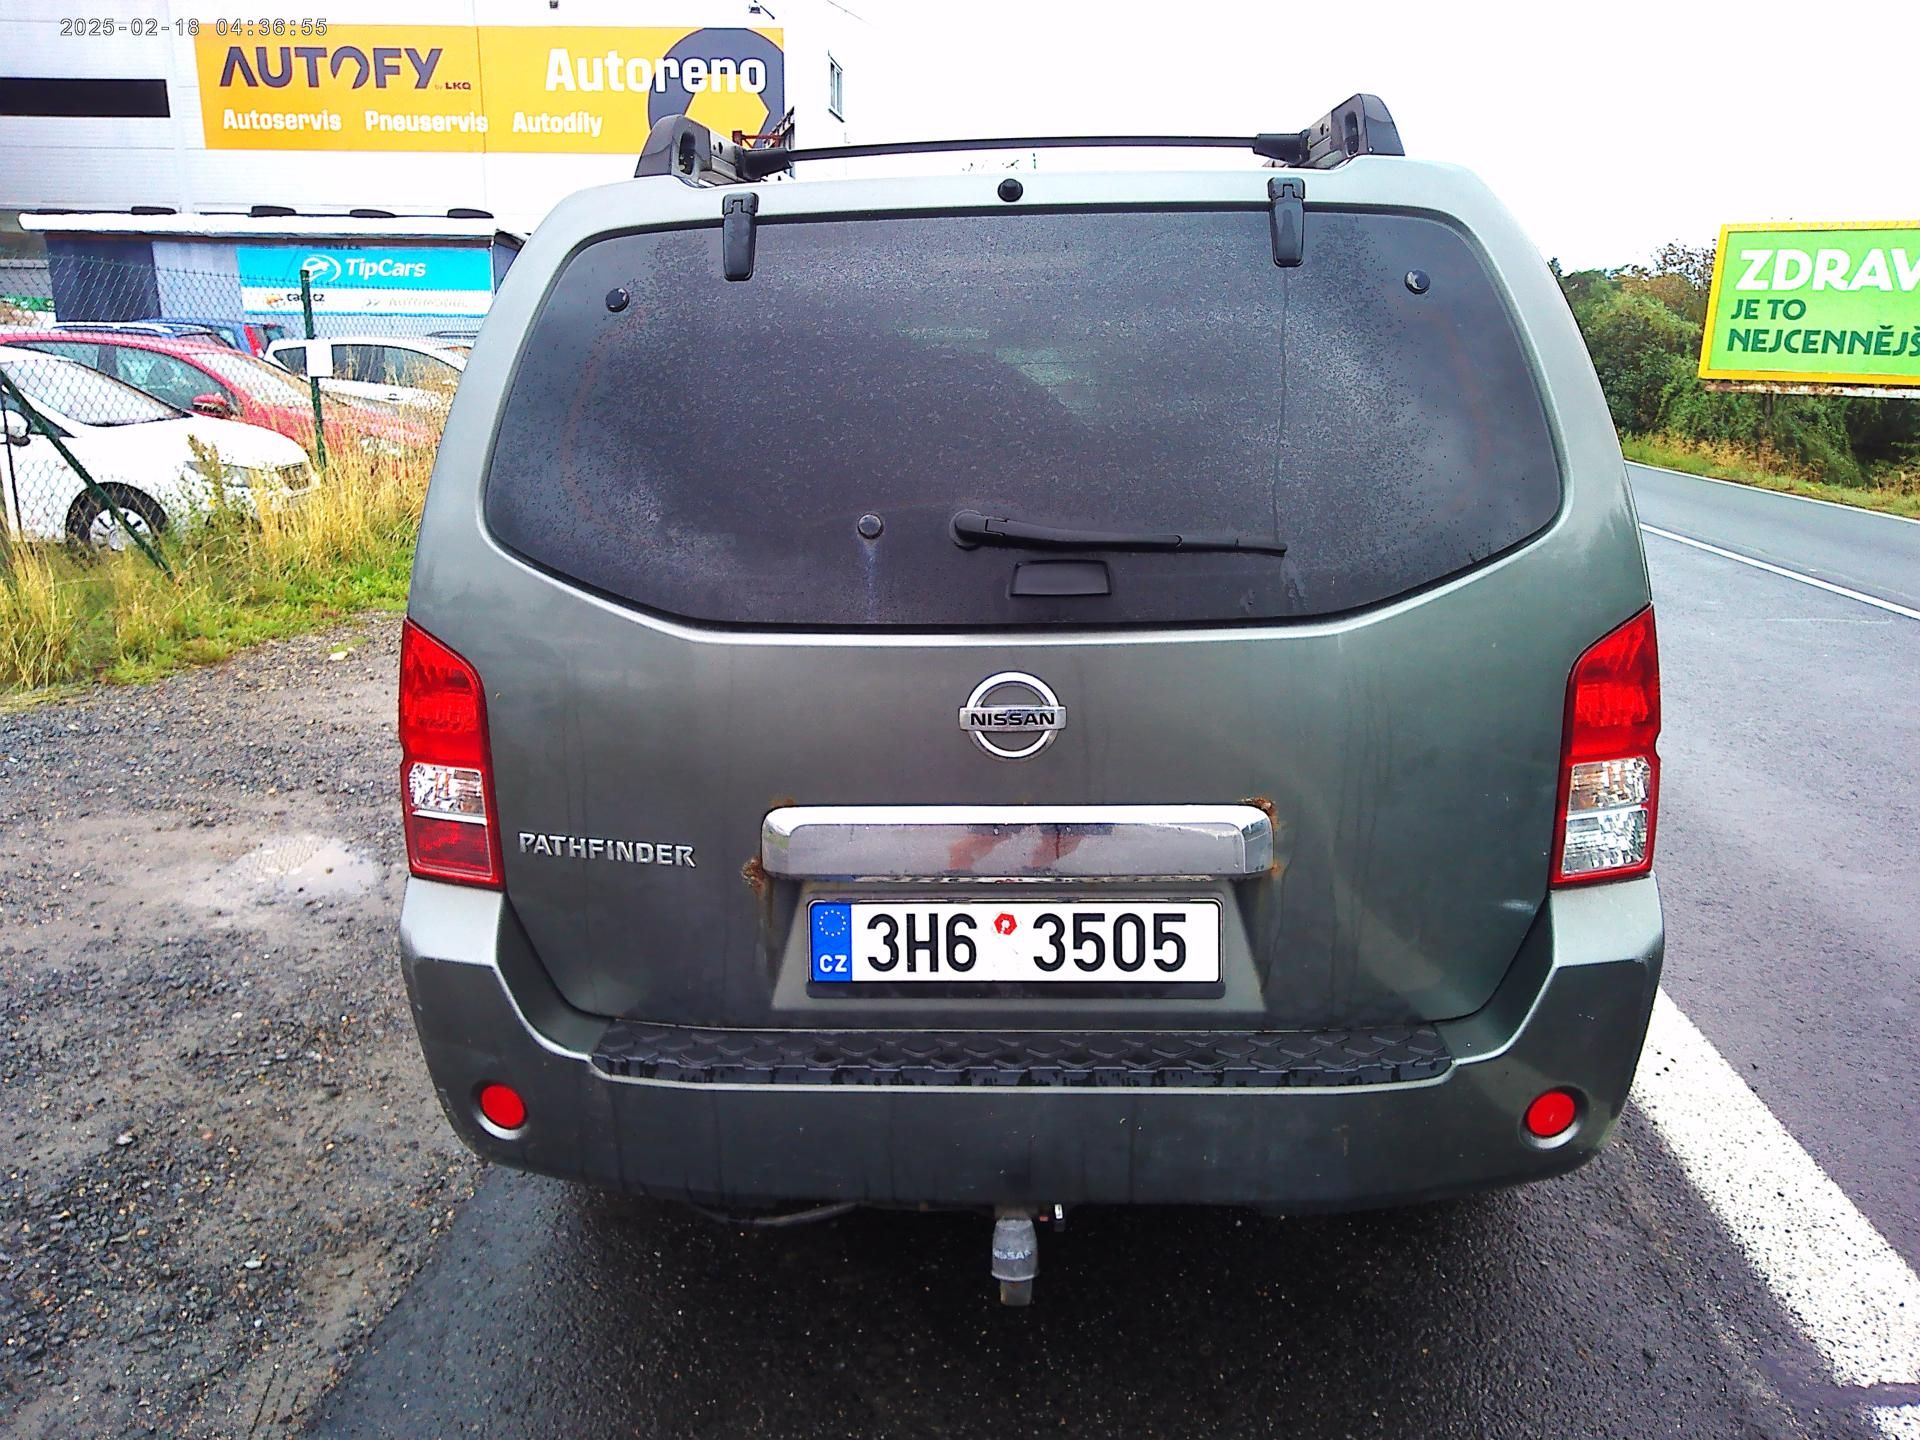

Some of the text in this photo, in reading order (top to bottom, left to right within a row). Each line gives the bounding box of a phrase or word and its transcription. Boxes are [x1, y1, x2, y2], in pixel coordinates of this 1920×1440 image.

[219, 46, 443, 90] AUTOFY
[545, 48, 766, 94] Autoreno
[445, 82, 471, 90] LKQ
[223, 109, 602, 137] Autoservis Pneuservis Autodíly
[345, 258, 426, 280] TipCars
[1731, 299, 1806, 320] JE TO
[970, 712, 1055, 726] NISSAN
[518, 831, 697, 868] PATHFINDER
[819, 913, 1187, 973] CZ 3H6 3505
